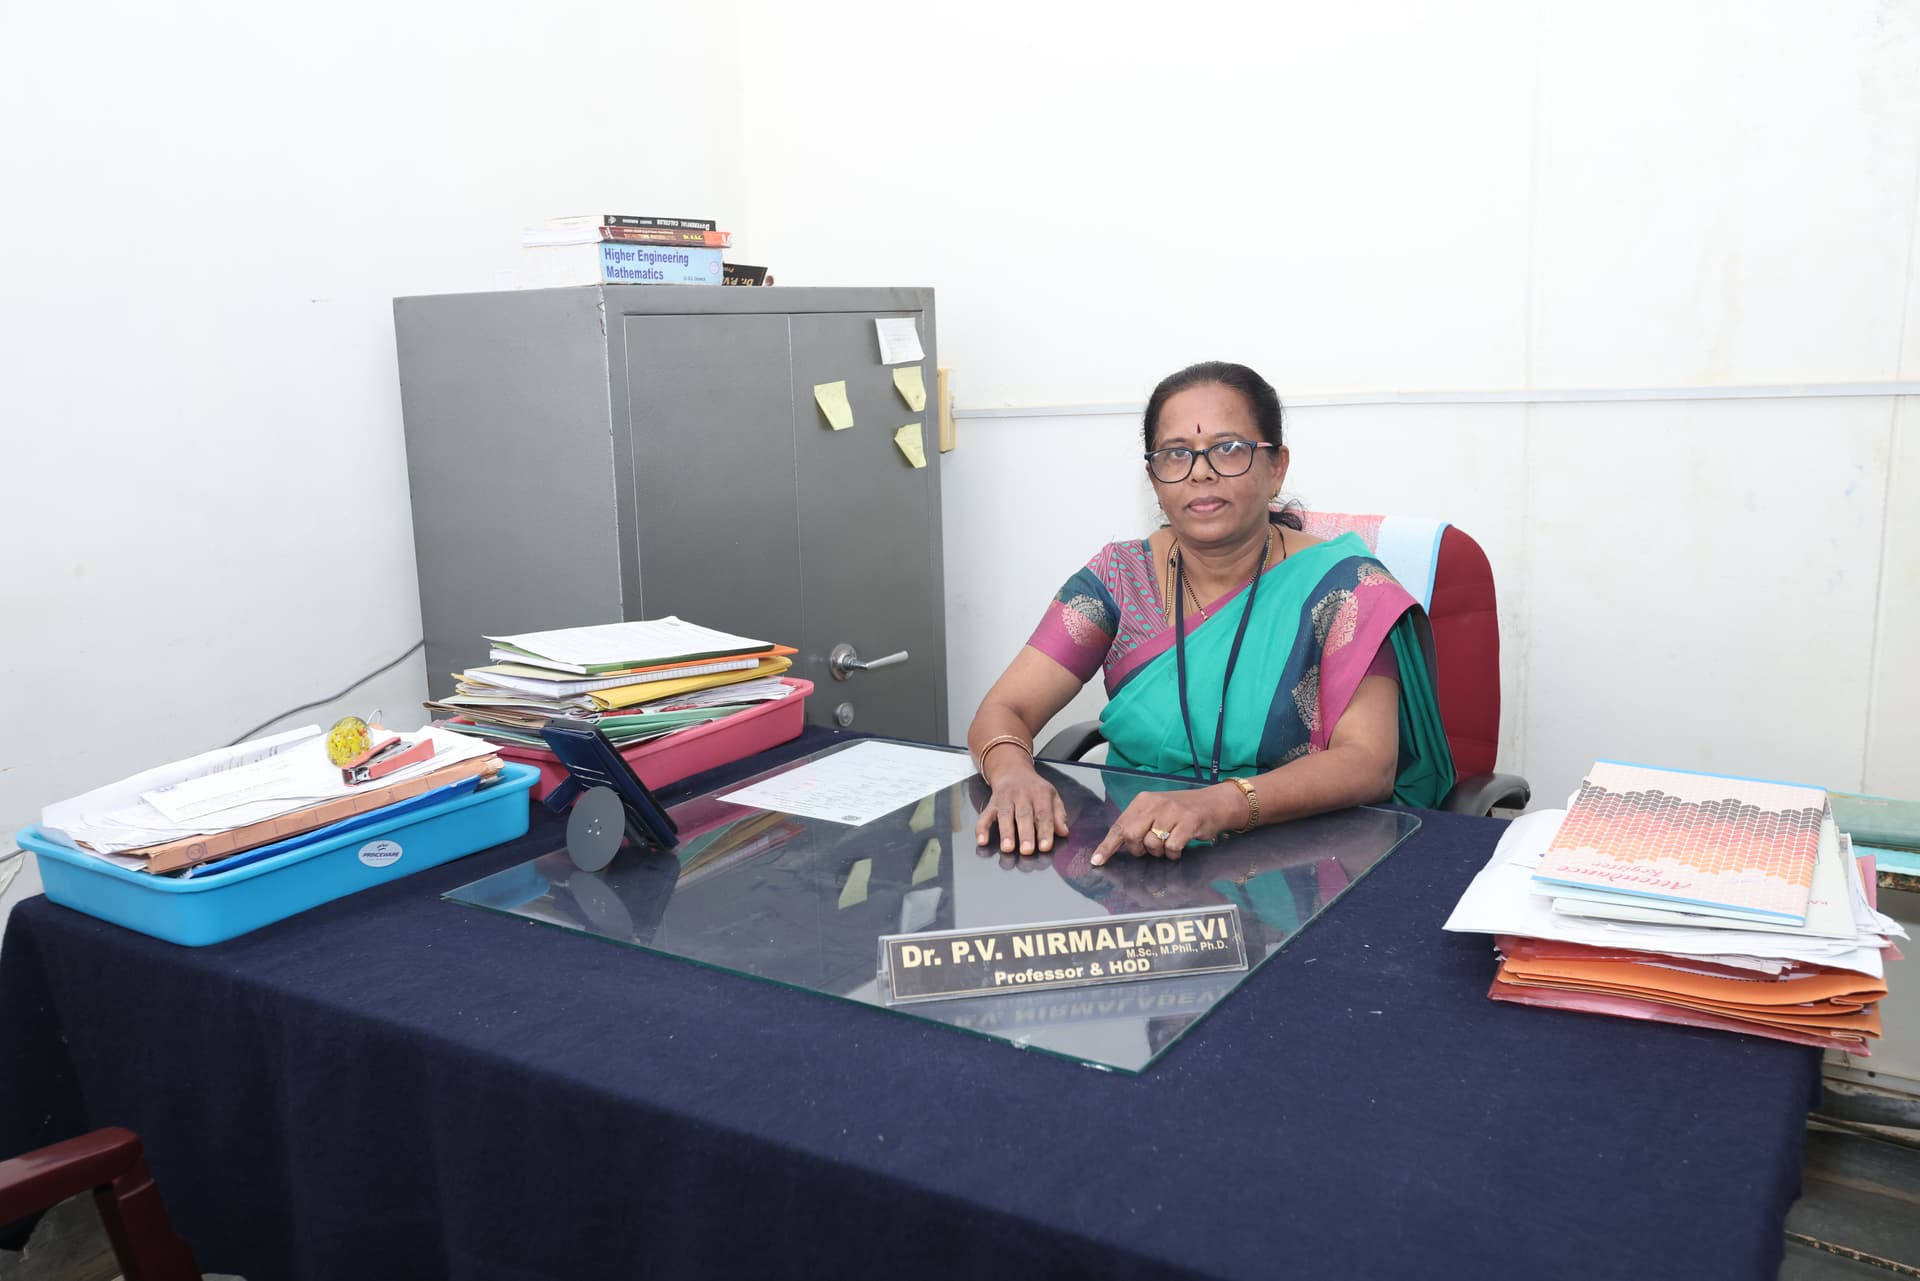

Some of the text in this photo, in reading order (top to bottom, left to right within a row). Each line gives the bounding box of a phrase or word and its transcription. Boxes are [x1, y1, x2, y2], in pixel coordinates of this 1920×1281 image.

[604, 247, 689, 267] Higher Engineering
[606, 265, 664, 280] Mathematics
[1555, 866, 1692, 890] Attendance
[1591, 863, 1664, 877] Register
[901, 917, 1228, 969] Dr. P.V. NIRMALADEVI
[1200, 940, 1229, 951] Ph.D.
[994, 958, 1151, 986] Professor & HOD
